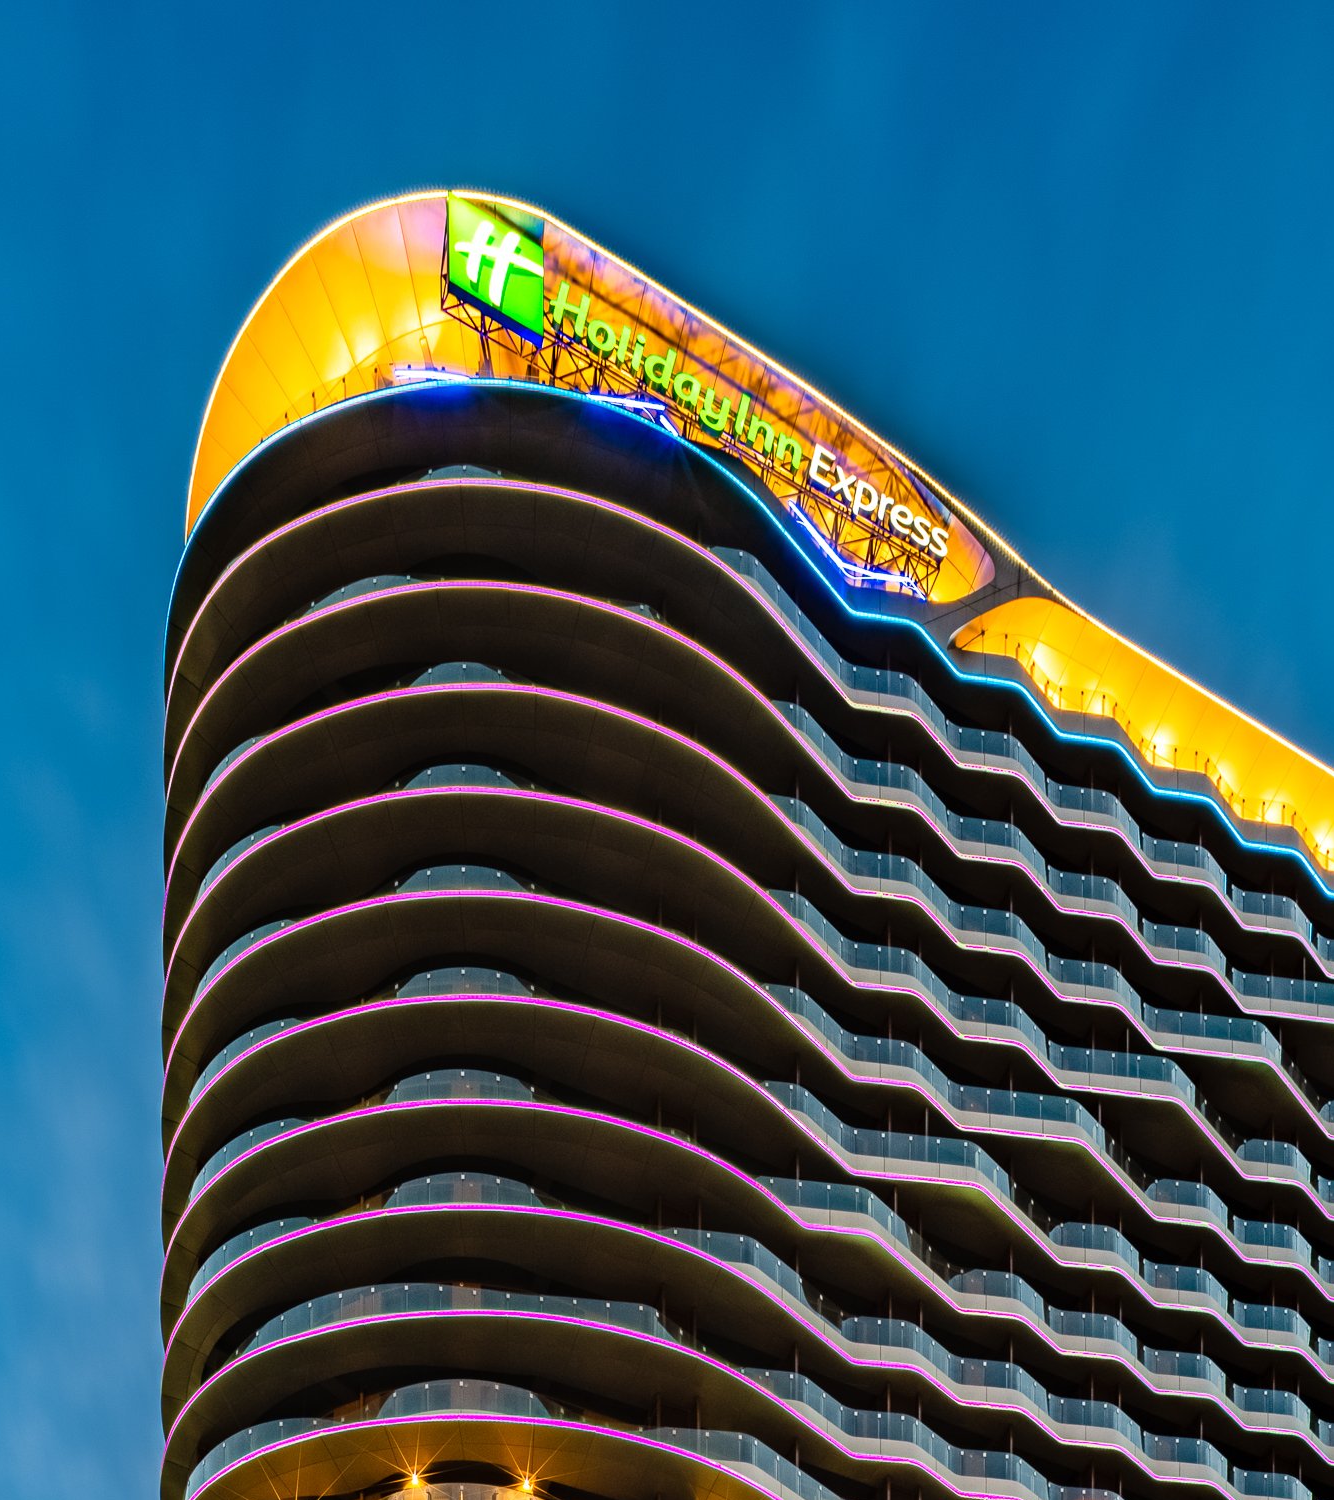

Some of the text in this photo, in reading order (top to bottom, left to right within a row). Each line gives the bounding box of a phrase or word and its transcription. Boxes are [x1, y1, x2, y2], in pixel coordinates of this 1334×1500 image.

[550, 281, 950, 558] Holiday Inn Express
